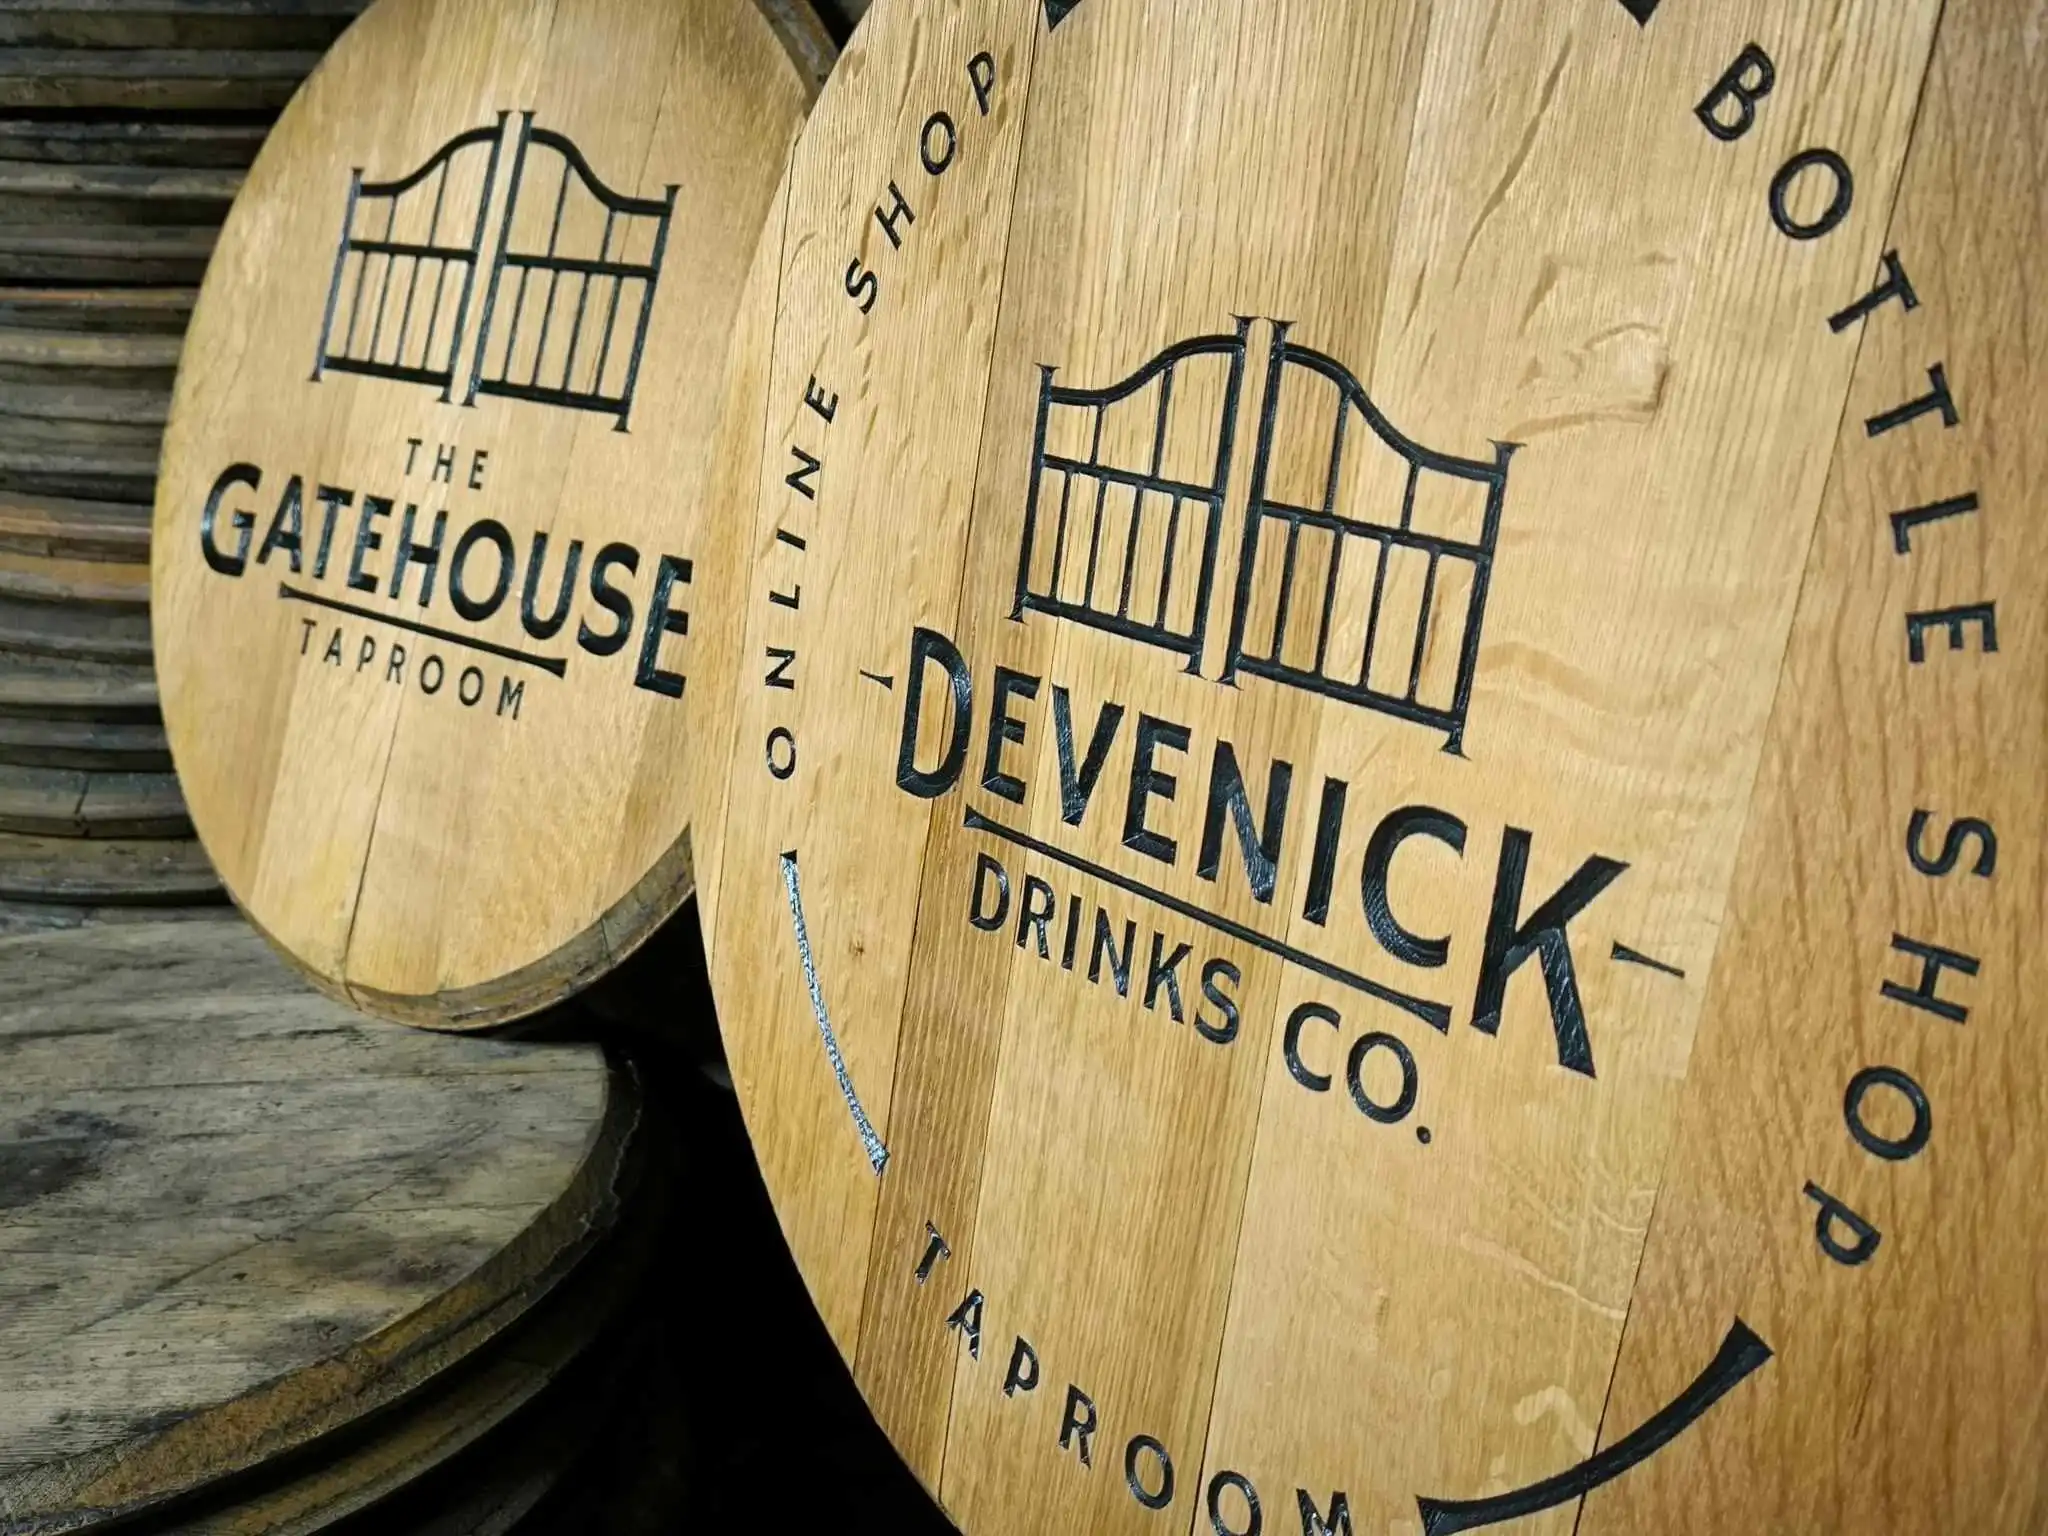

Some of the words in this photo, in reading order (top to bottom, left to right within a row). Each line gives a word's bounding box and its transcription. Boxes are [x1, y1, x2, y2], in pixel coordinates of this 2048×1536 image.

[405, 437, 489, 490] THE
[765, 373, 838, 780] ONLINE
[844, 51, 996, 315] SHOP
[1693, 42, 1999, 663] BOTTLE
[200, 461, 694, 699] GATEHOUSE
[300, 618, 525, 720] TAPROOM
[894, 626, 1631, 1080] DEVENICK
[969, 851, 1242, 1045] DRINKS
[1282, 1001, 1432, 1145] CO.
[1802, 808, 1998, 1267] SHOP
[914, 1220, 1353, 1536] TAPROOM
